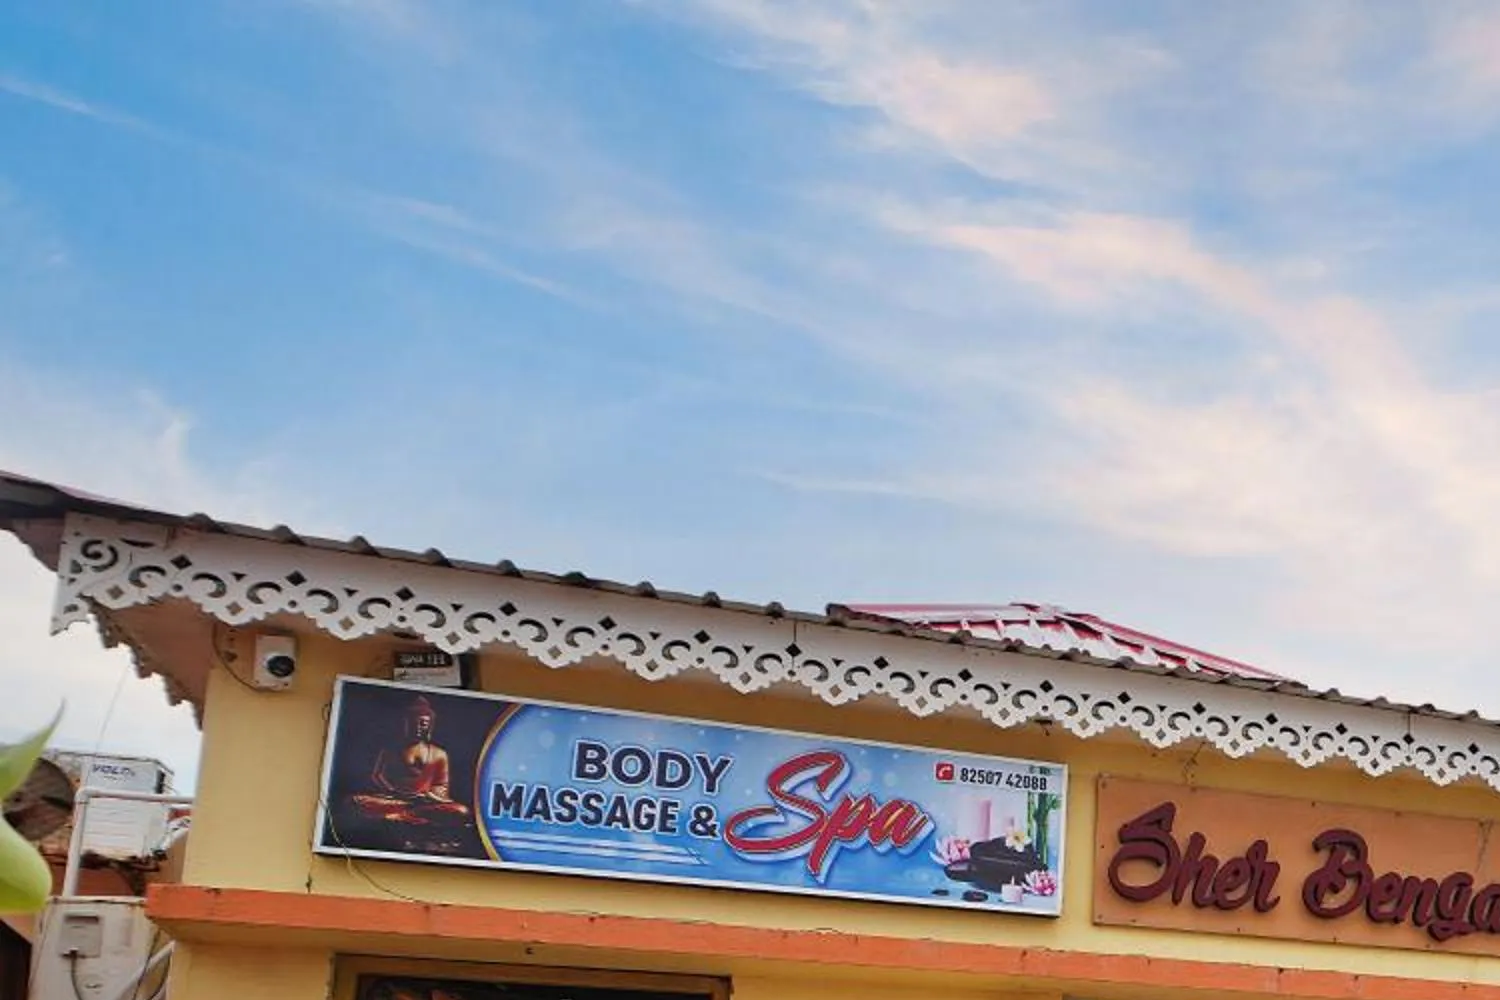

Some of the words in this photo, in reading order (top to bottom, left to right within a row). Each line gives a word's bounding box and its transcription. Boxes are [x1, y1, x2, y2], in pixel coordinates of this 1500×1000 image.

[573, 739, 732, 794] BODY
[960, 767, 1002, 786] 82507
[490, 783, 681, 836] MASSAGE
[688, 802, 721, 840] &
[723, 750, 936, 884] Spa
[1107, 801, 1282, 912] Sher
